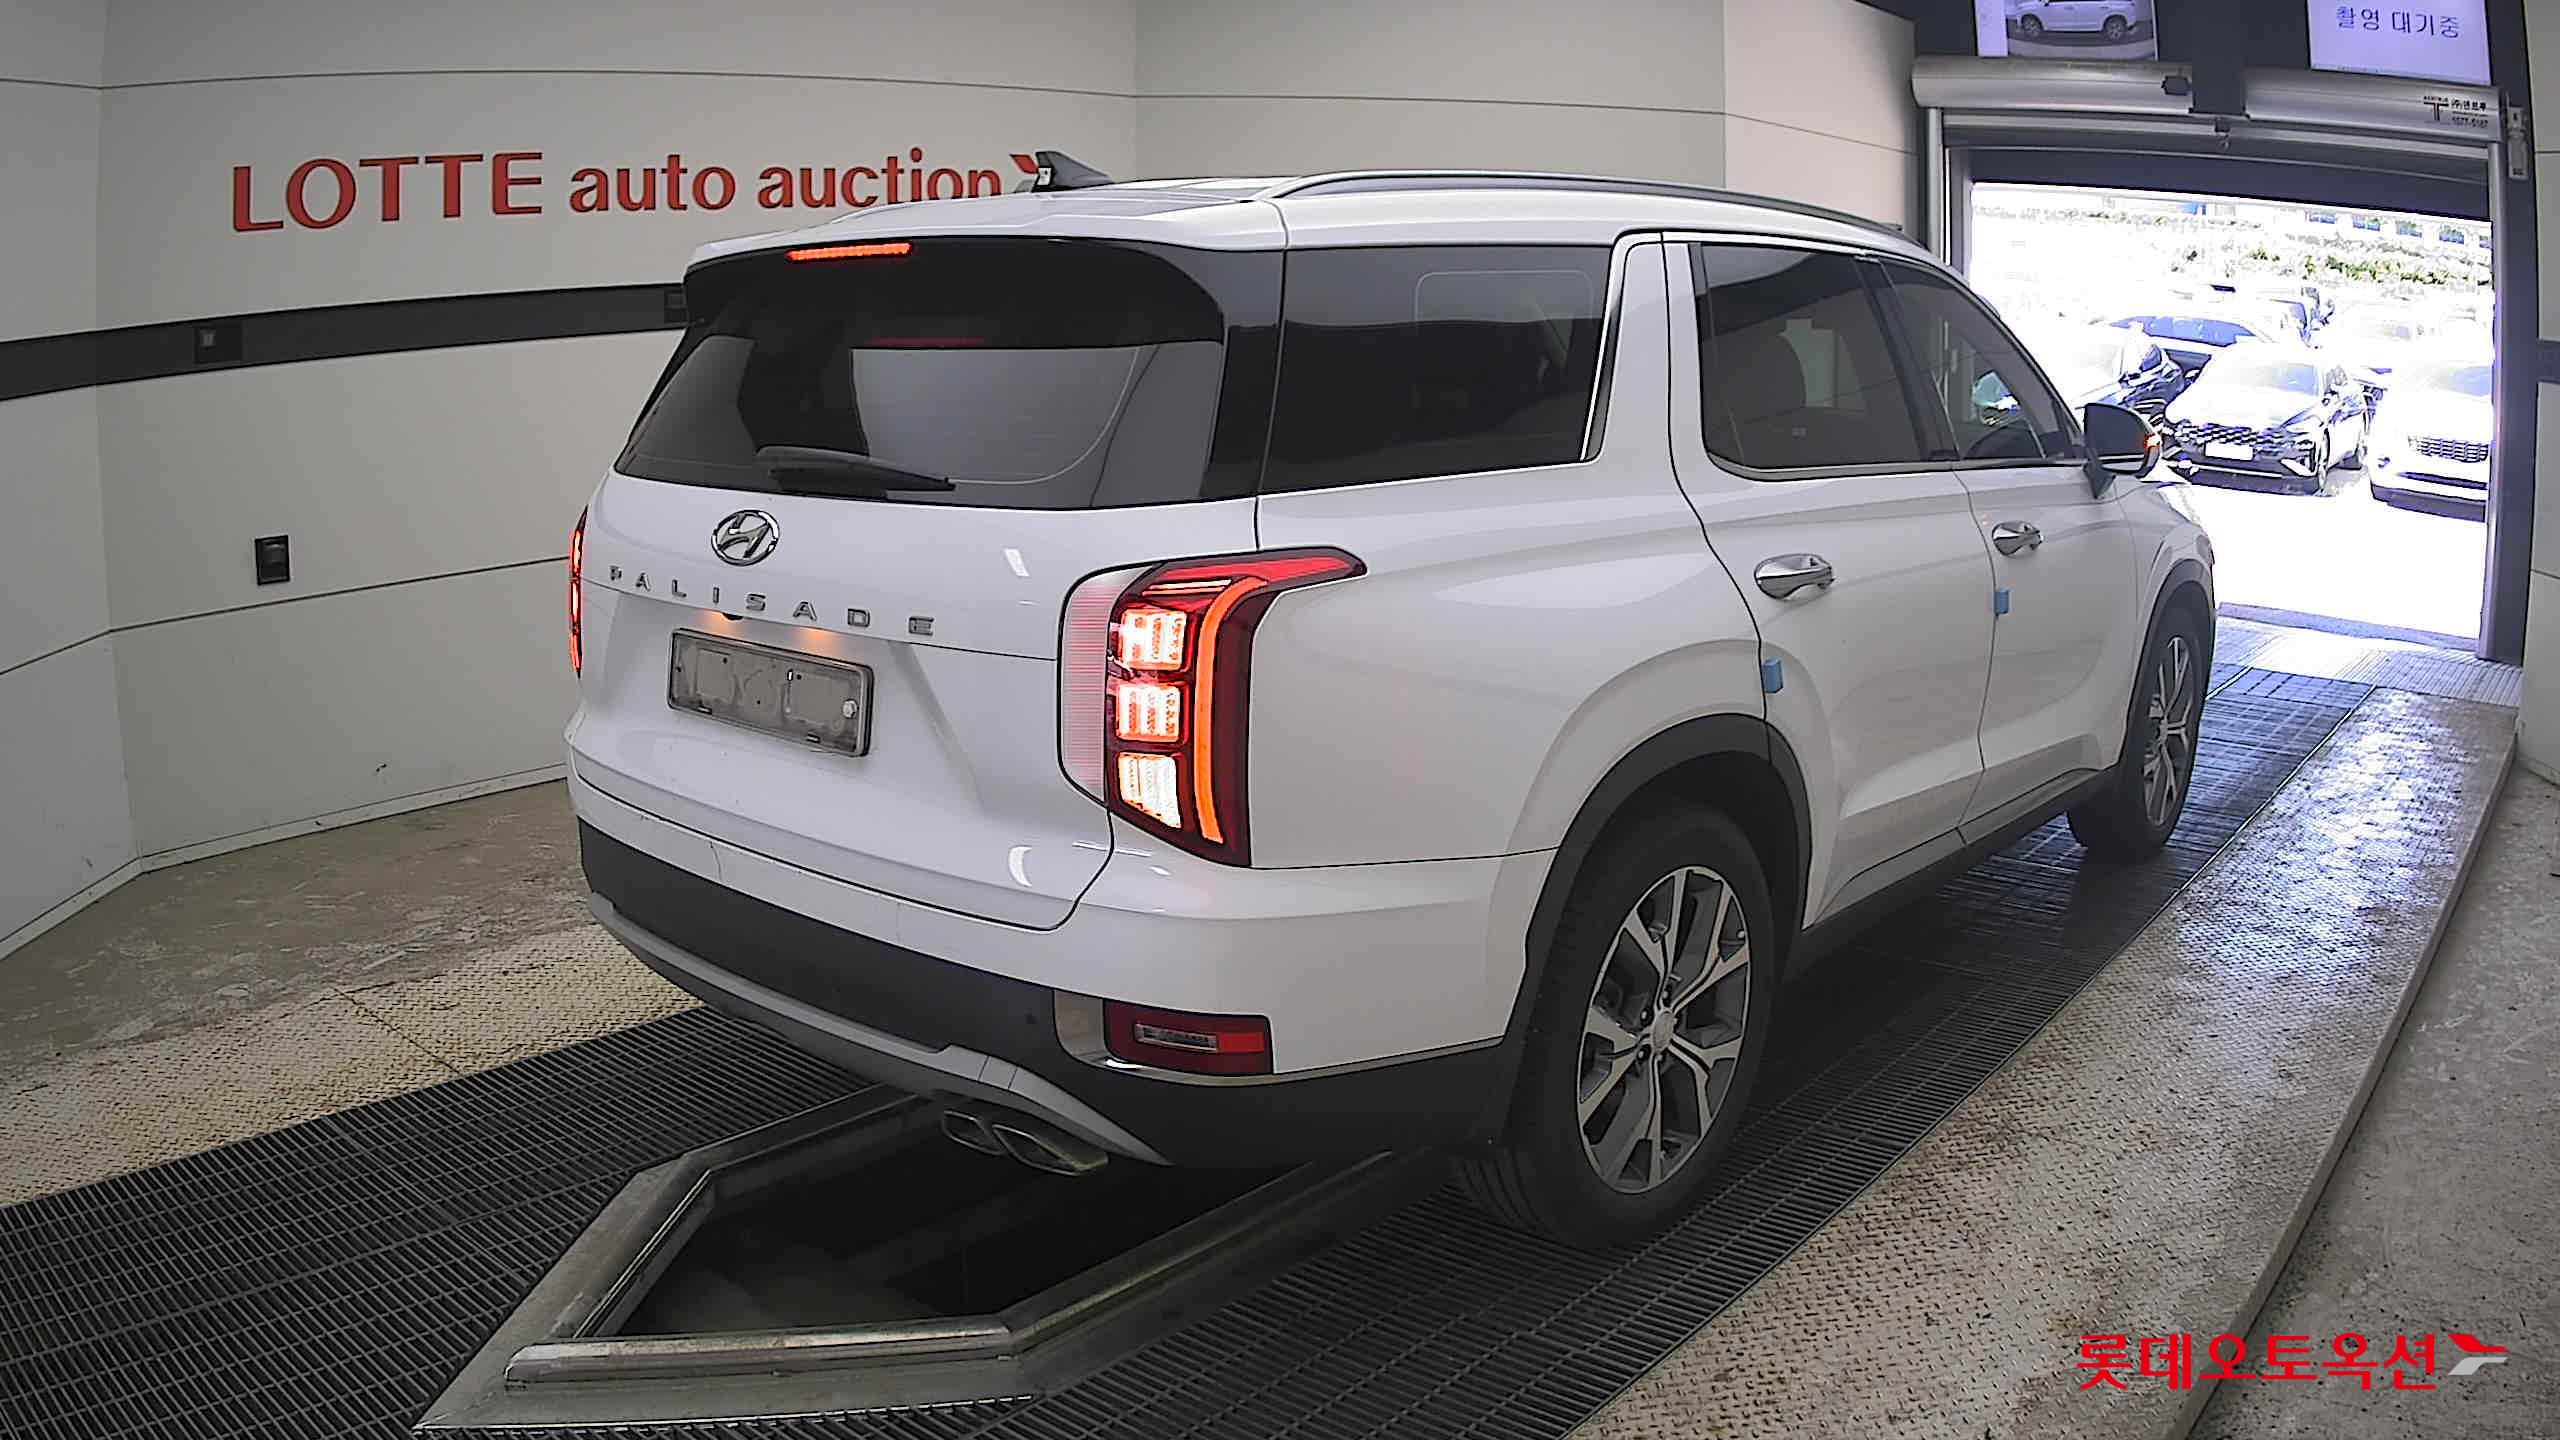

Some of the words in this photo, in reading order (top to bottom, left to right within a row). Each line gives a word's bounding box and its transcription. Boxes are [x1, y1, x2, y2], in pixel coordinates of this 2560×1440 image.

[2336, 6, 2380, 31] 촬영
[2391, 11, 2460, 39] 대기중
[233, 152, 543, 232] LOTTE
[568, 154, 736, 213] auto
[757, 147, 1002, 208] auction
[609, 565, 936, 637] PALISADE
